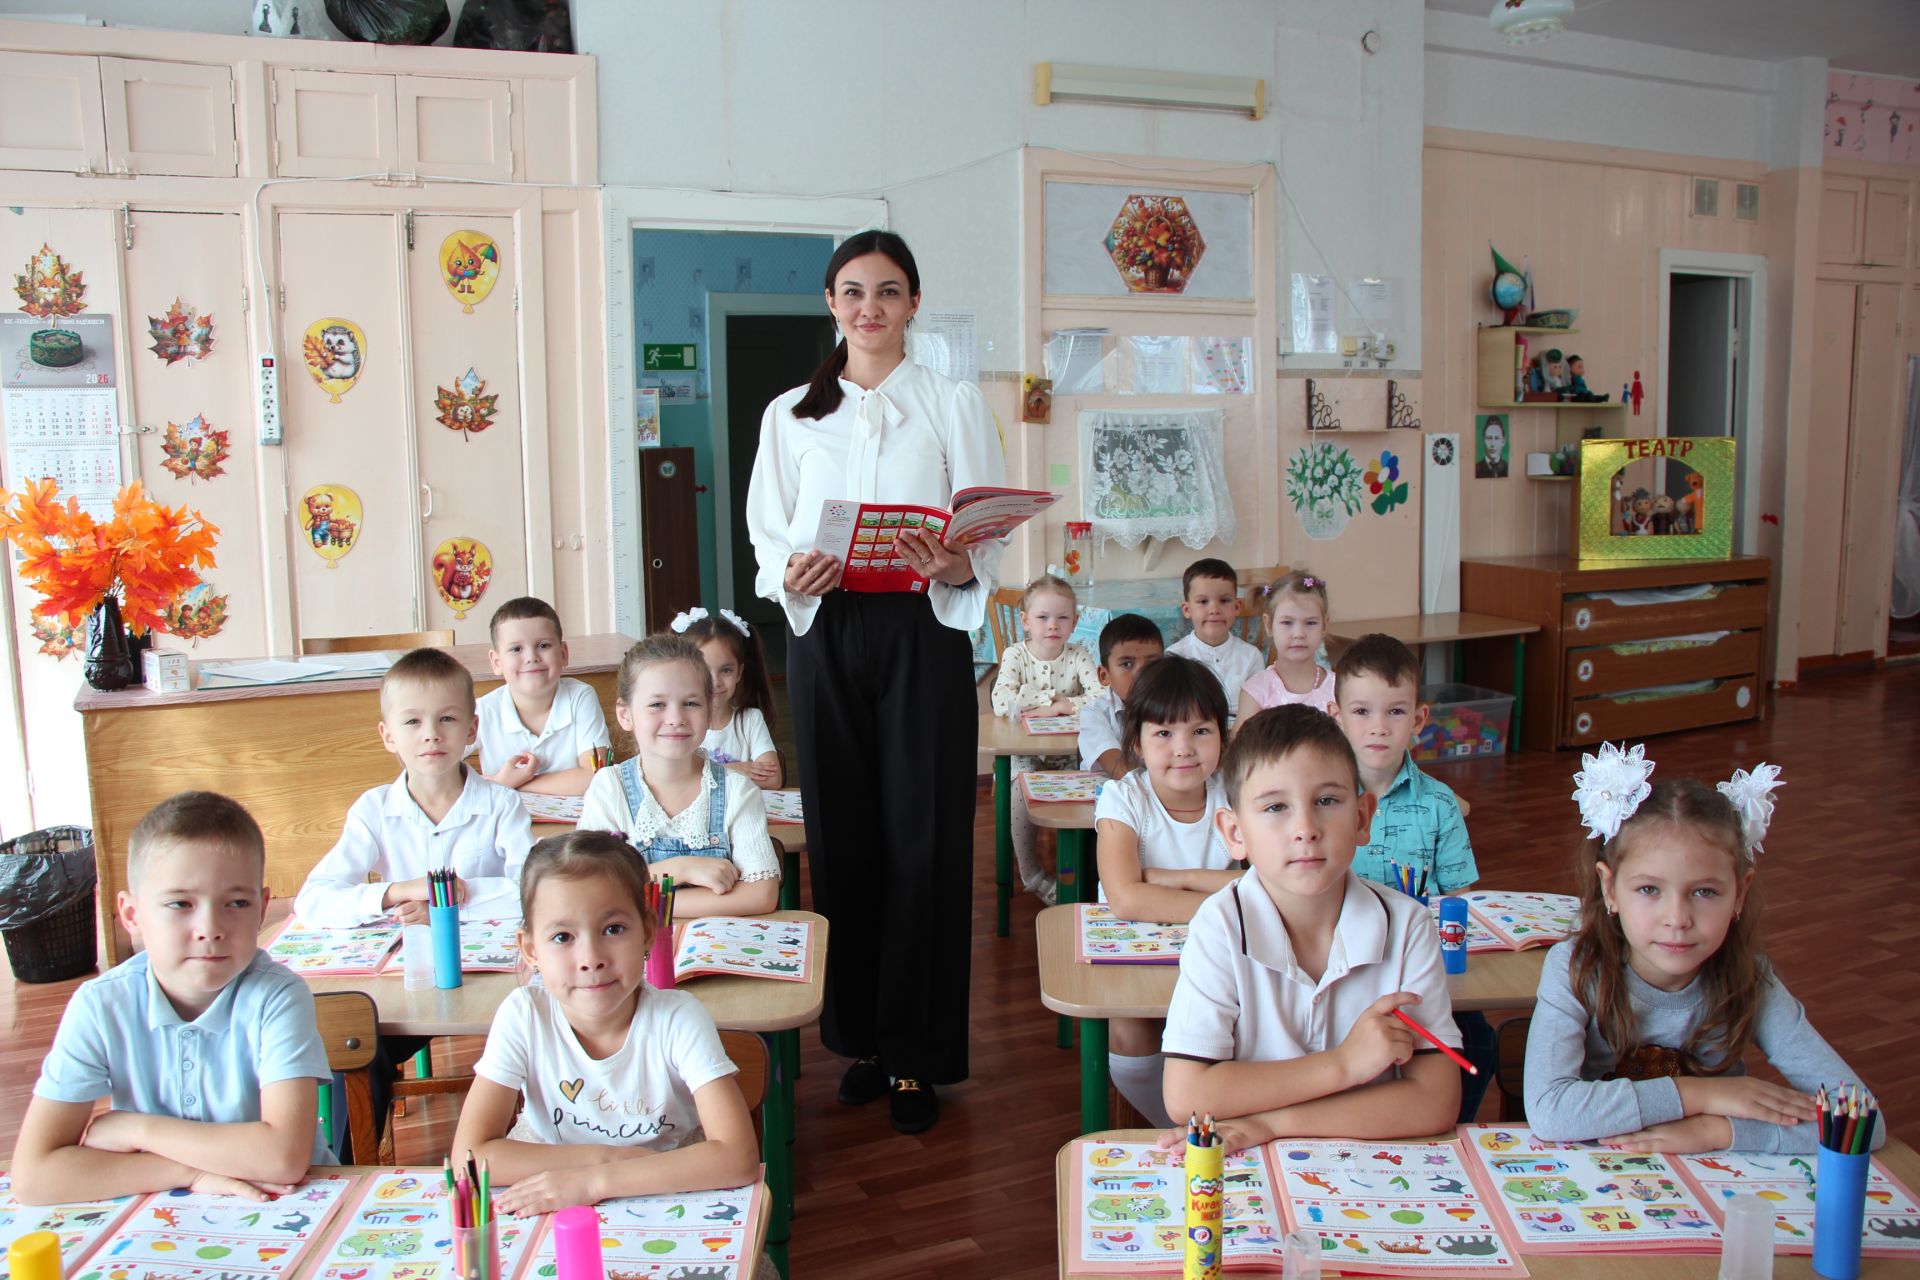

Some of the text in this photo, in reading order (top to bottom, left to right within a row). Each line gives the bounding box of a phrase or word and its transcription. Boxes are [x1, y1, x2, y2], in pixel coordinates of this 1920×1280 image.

[86, 374, 108, 384] 2026
[1623, 439, 1694, 459] ТЕАТР
[1505, 1165, 1525, 1173] Щ
[1103, 1182, 1120, 1190] Щ
[1532, 1194, 1547, 1202] Ц
[1115, 1212, 1127, 1220] Ц
